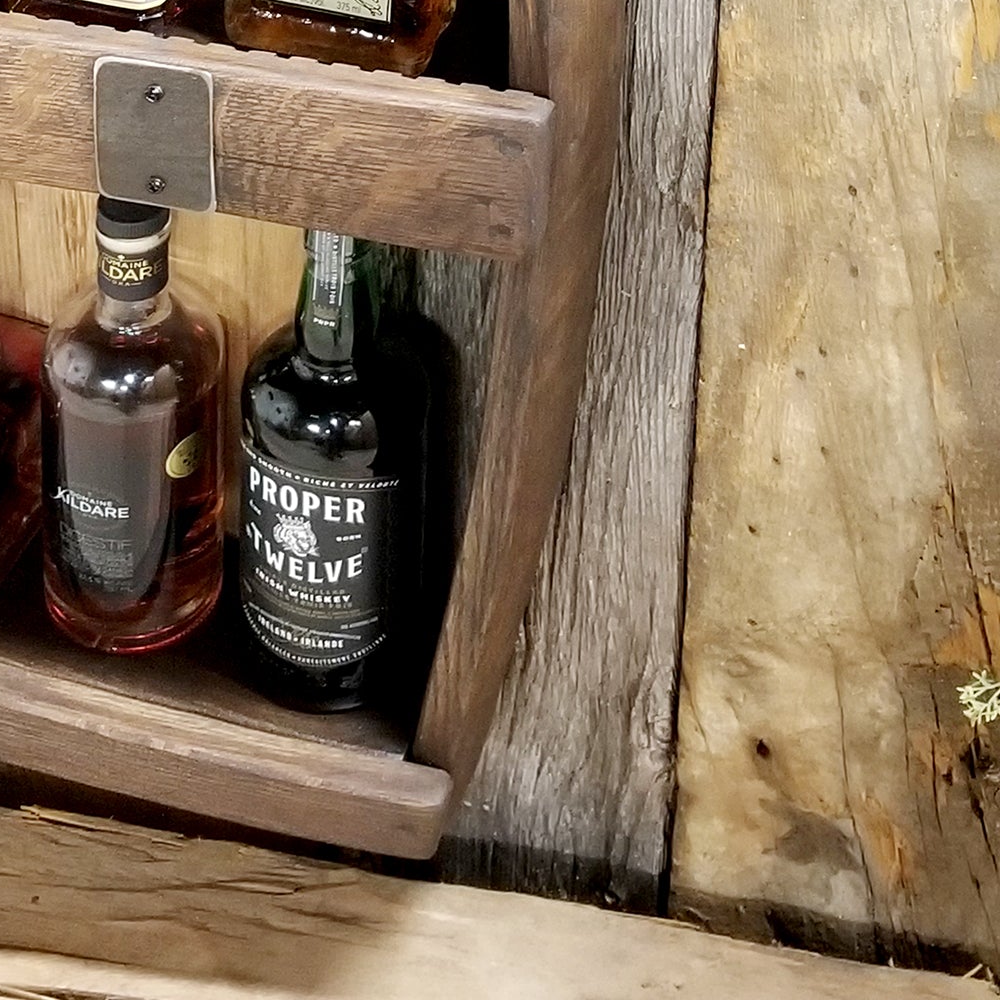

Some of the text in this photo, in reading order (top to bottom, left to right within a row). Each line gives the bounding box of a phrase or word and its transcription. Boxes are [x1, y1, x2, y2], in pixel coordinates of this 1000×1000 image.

[250, 466, 365, 524] PROPER
[246, 522, 364, 584] TWELVE
[288, 588, 351, 603] WHISKEY
